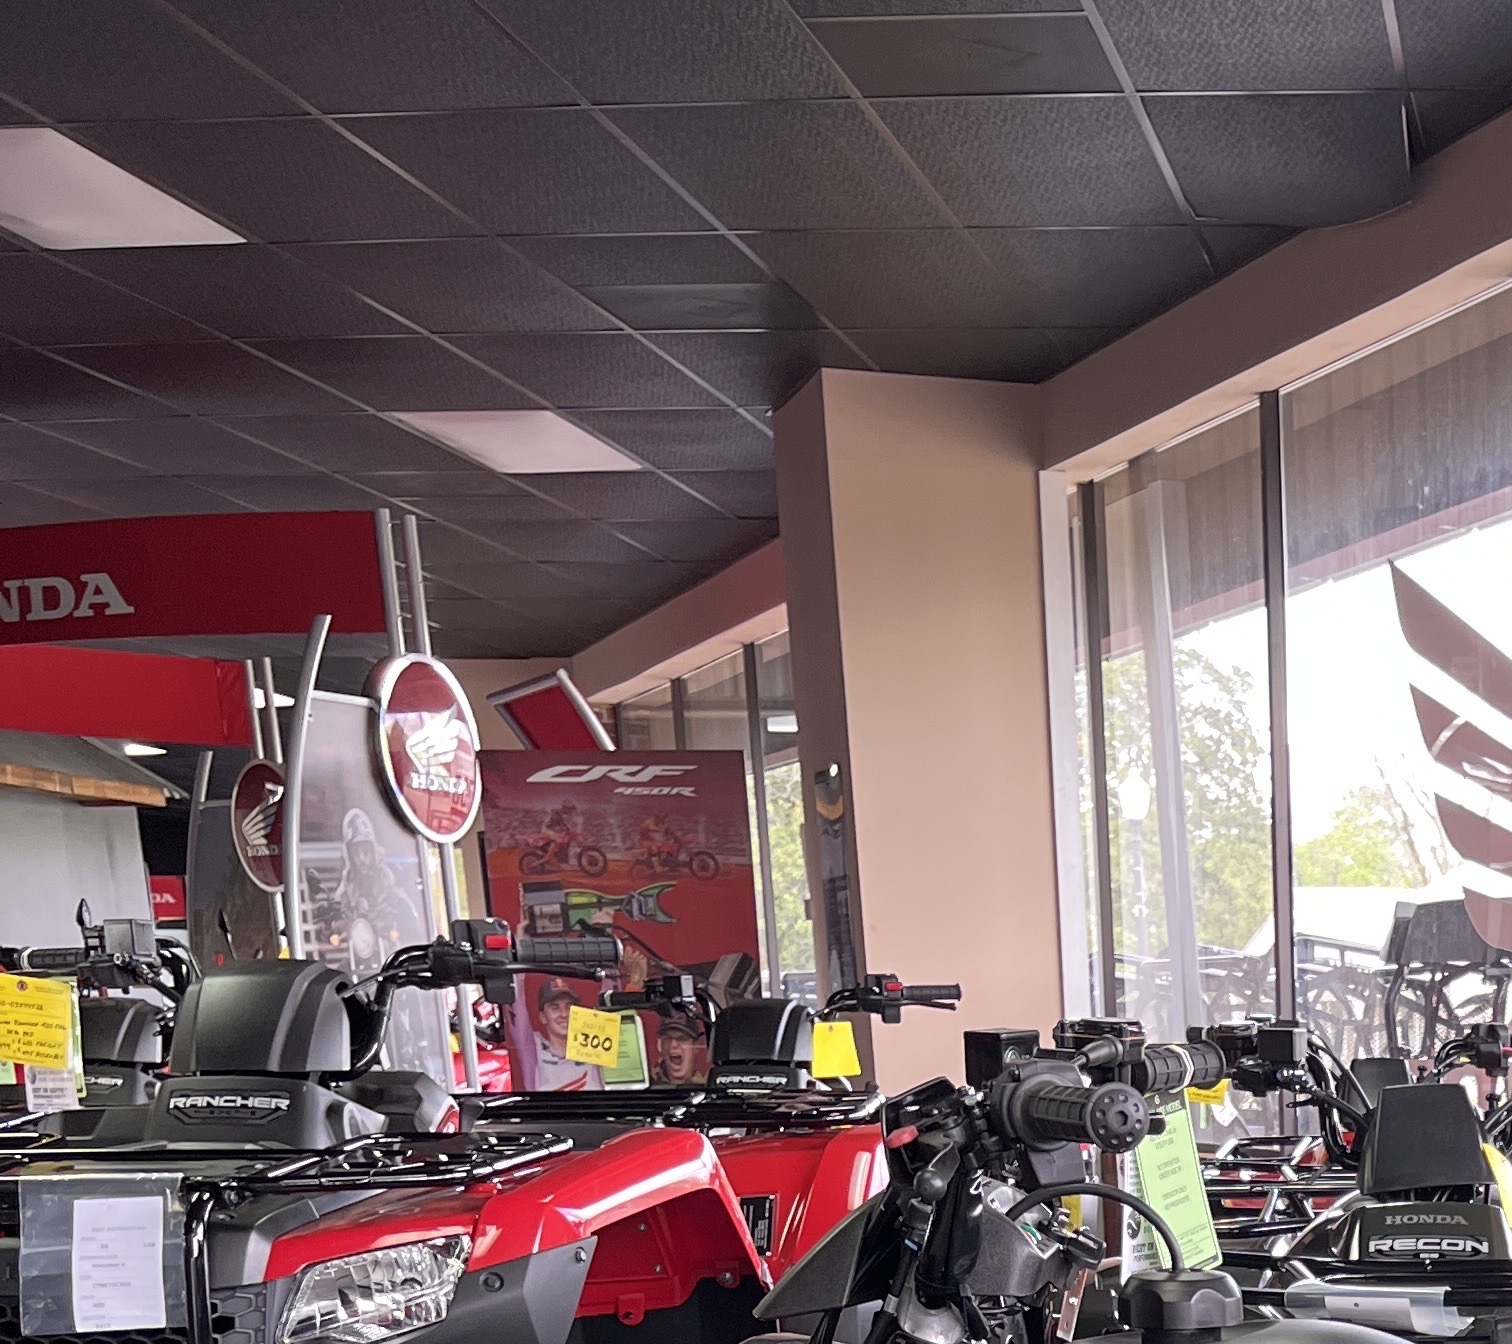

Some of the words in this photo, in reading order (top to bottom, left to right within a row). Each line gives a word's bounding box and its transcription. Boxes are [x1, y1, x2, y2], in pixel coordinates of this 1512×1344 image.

[525, 765, 698, 783] CRF
[613, 786, 697, 798] 450R
[246, 845, 282, 857] HOND
[716, 1075, 787, 1085] RANCHER
[169, 1095, 290, 1110] RANCHER
[1384, 1214, 1469, 1226] HONDA
[1368, 1238, 1490, 1253] RECON
